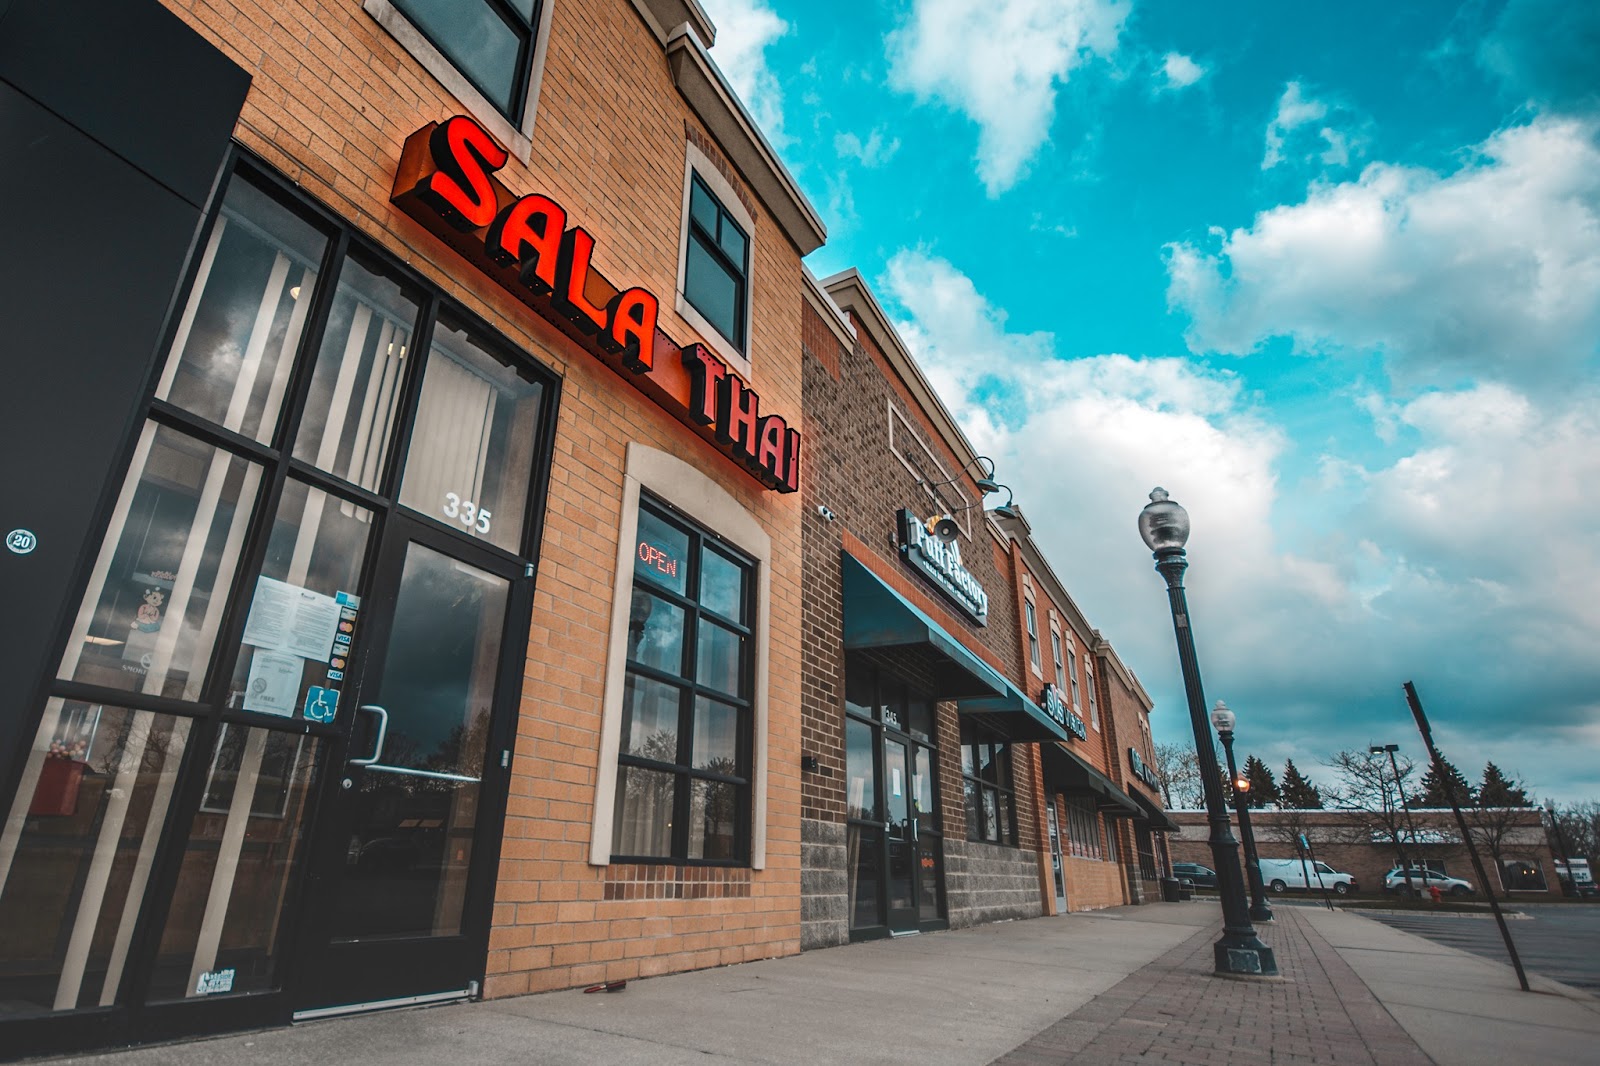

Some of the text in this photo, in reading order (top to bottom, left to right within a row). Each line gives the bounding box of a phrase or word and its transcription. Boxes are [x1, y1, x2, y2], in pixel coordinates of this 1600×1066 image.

[426, 115, 800, 493] SALA THAI
[443, 492, 491, 534] 335
[13, 534, 30, 548] 20
[638, 542, 676, 578] OPEN
[943, 547, 988, 616] Factory
[337, 634, 351, 643] VISA
[329, 671, 342, 679] VISA
